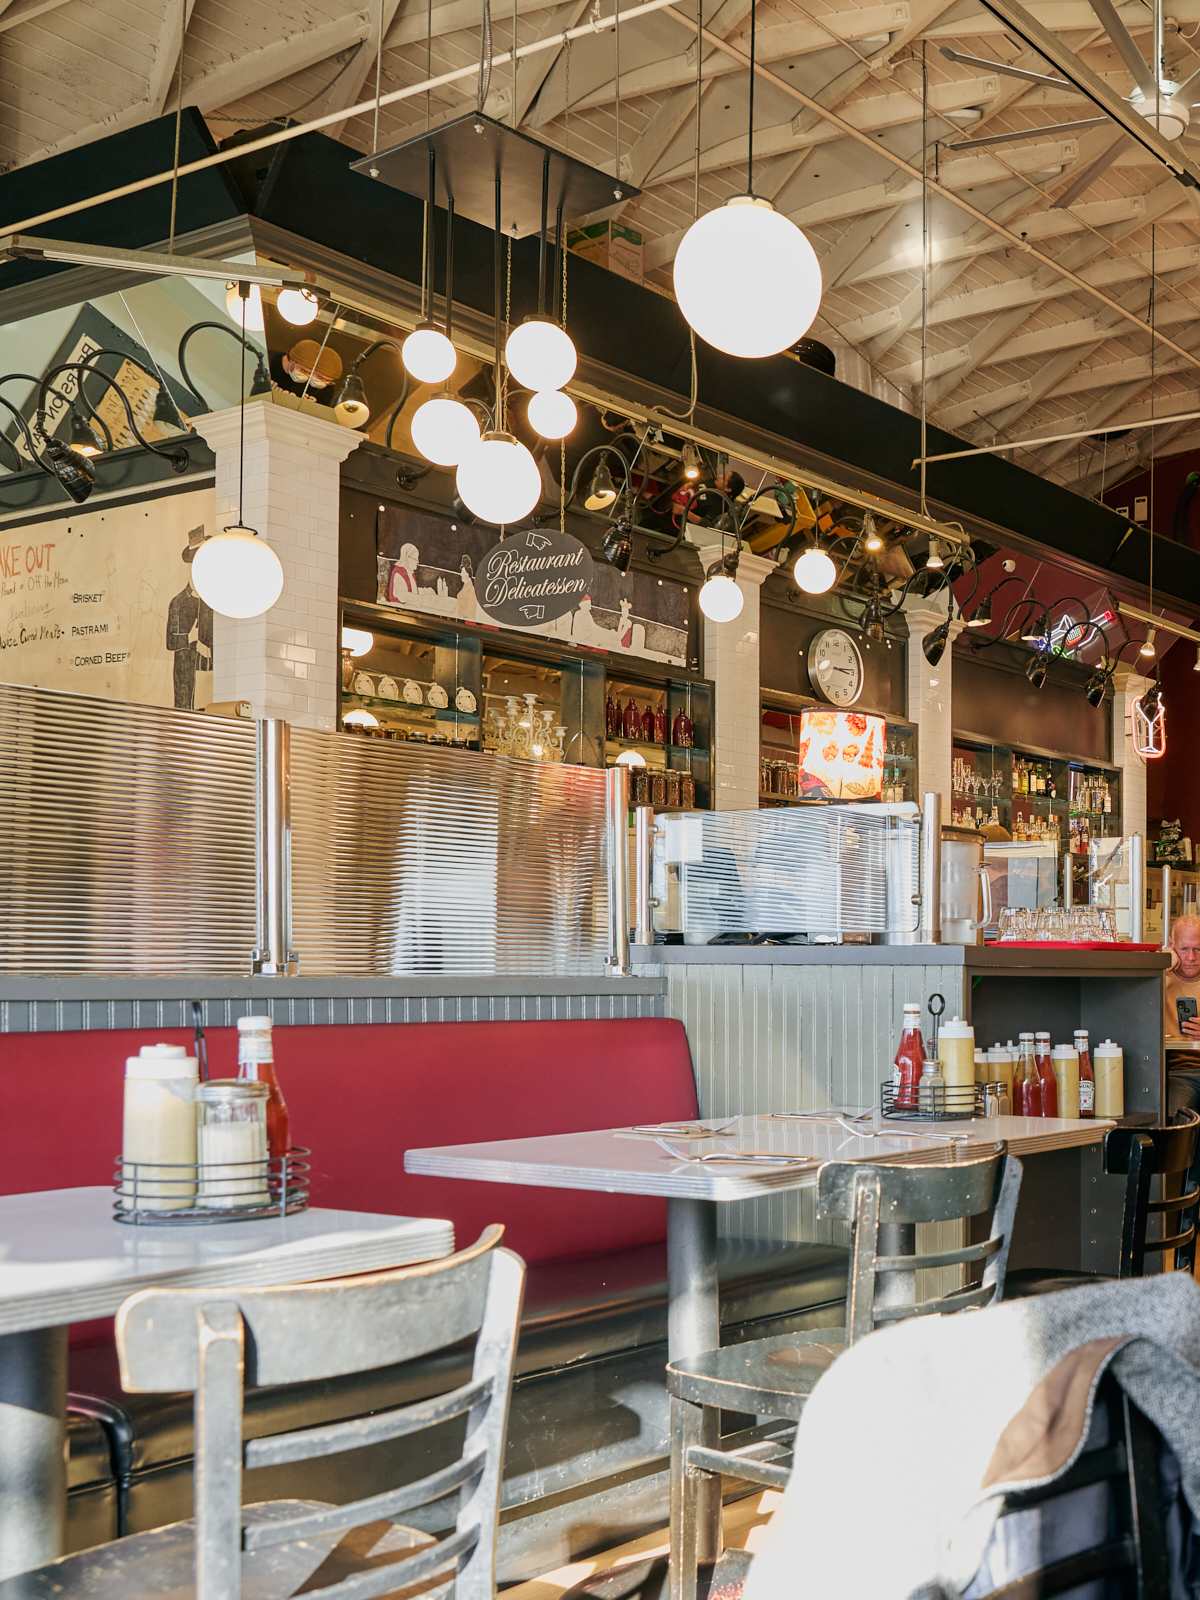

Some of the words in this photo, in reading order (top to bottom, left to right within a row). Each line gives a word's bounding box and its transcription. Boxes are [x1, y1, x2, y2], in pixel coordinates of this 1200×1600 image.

[26, 544, 56, 573] OUT
[486, 547, 584, 580] Restaurant
[73, 593, 103, 604] BRISKET
[482, 575, 587, 607] Delicatessen
[72, 624, 109, 637] PASTRAMI
[75, 656, 102, 667] CORNED
[105, 653, 127, 664] BEEF
